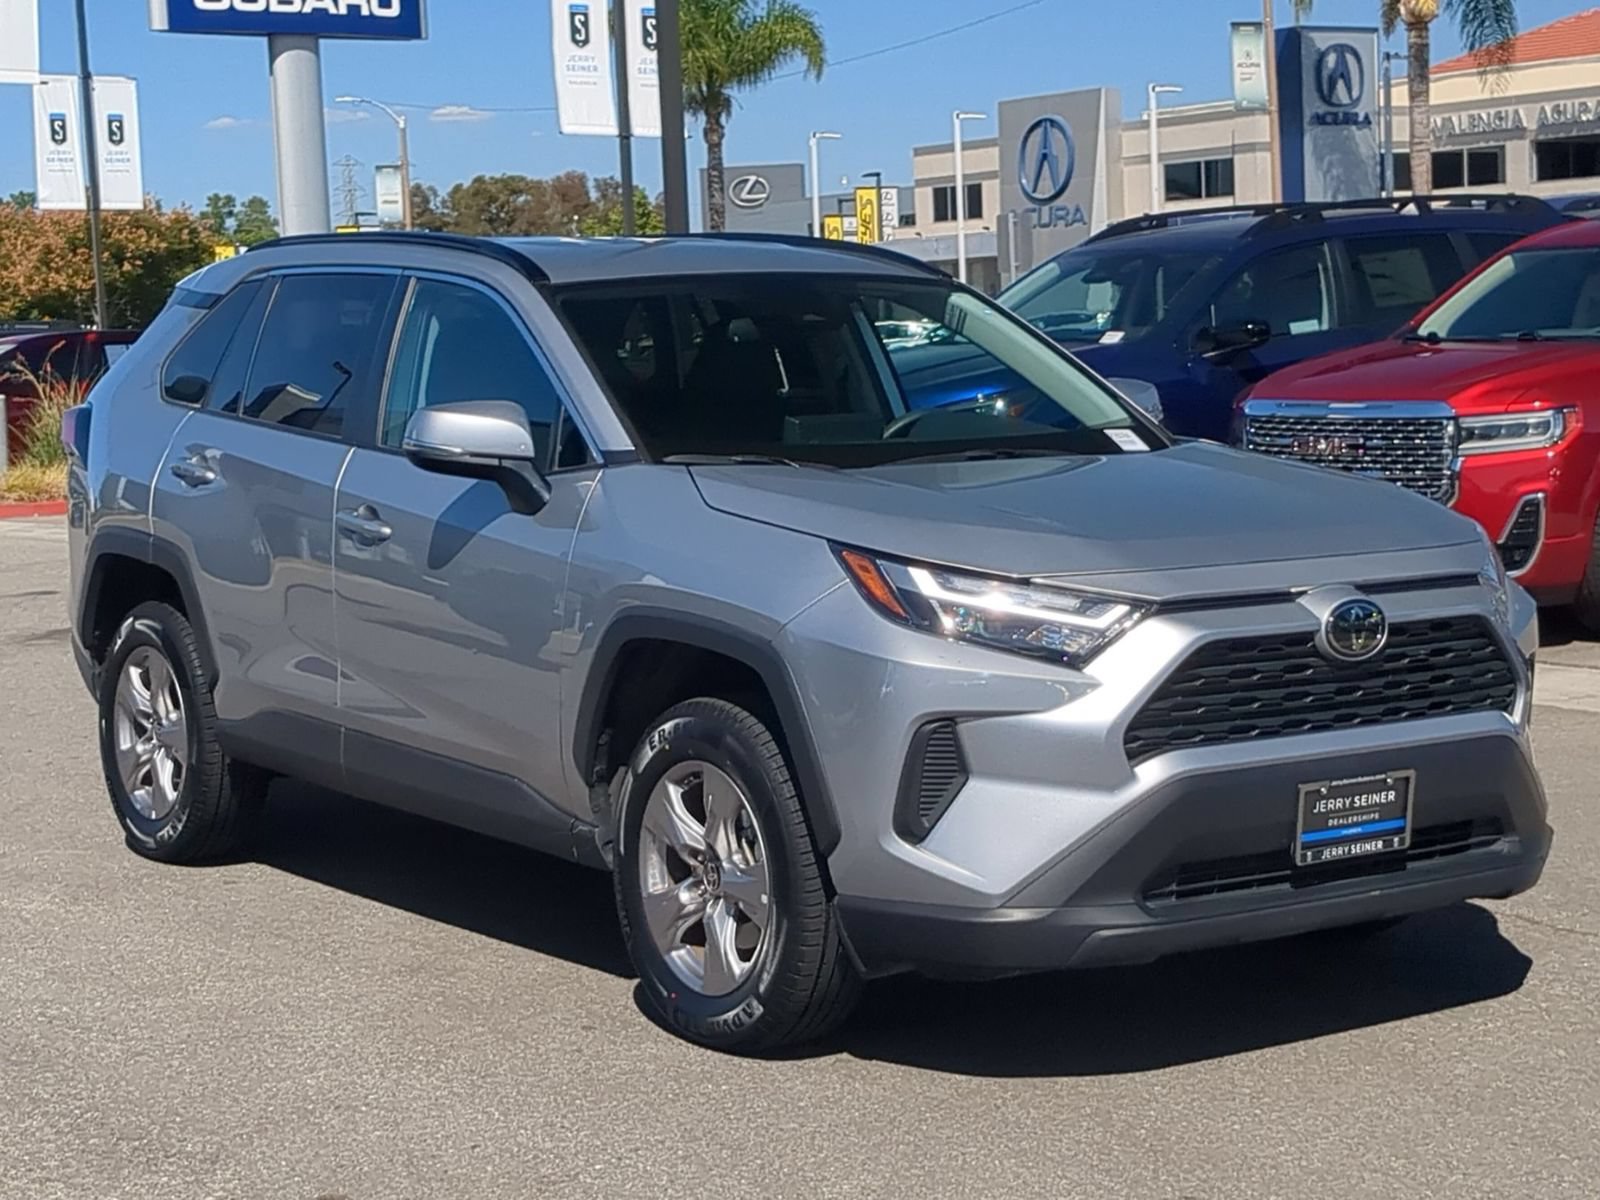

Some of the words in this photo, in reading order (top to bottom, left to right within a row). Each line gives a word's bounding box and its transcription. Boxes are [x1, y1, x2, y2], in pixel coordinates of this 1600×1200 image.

[567, 54, 596, 63] JERRY
[565, 64, 599, 73] SEINER
[1310, 111, 1372, 127] ACURA
[1431, 108, 1527, 135] VALENCIA
[1021, 204, 1088, 229] URA
[1313, 797, 1351, 813] JERRY
[1353, 790, 1396, 807] SEINER
[1328, 812, 1380, 827] DEALERSHIPS
[1321, 846, 1349, 859] JERRY
[1351, 840, 1384, 855] SEINER
